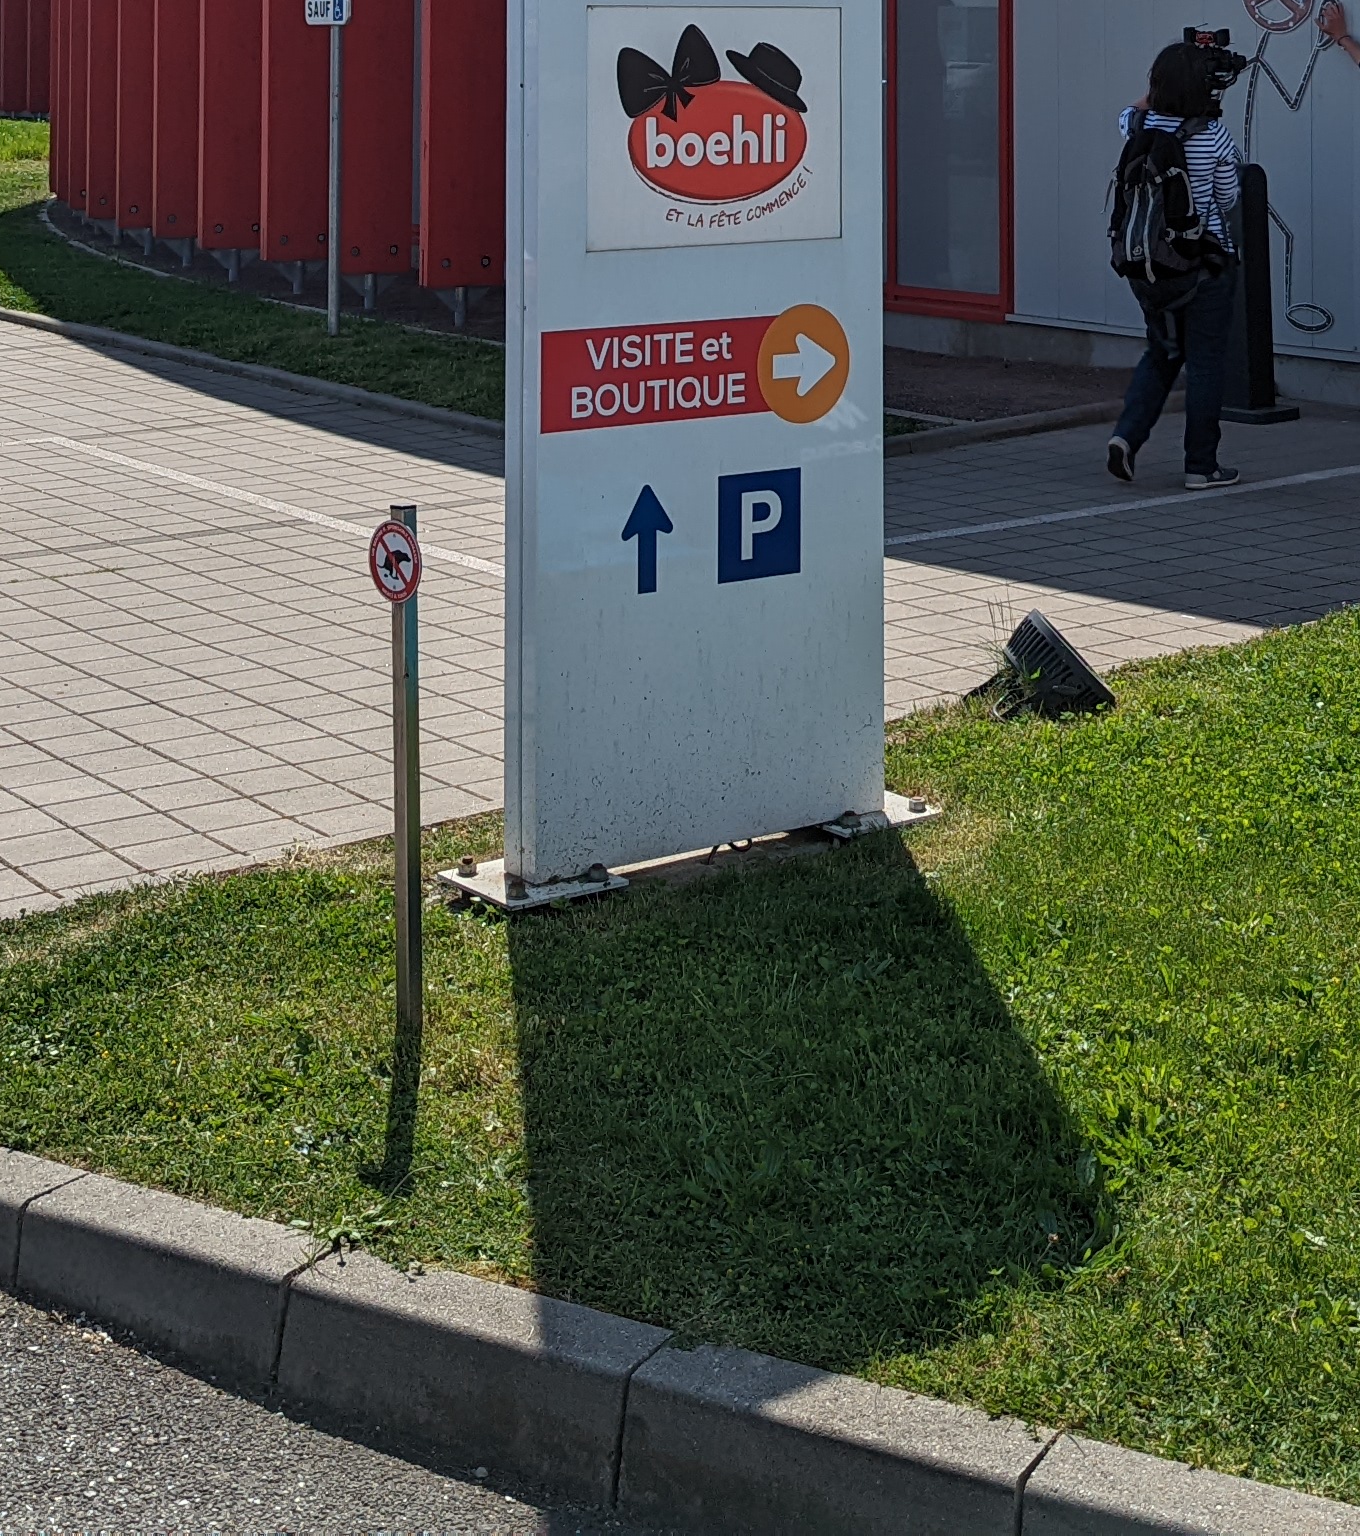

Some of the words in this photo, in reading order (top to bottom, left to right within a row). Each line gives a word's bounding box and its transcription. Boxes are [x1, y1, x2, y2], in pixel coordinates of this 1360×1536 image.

[307, 0, 331, 18] SAUF
[644, 113, 788, 168] boehli
[665, 207, 685, 224] ET
[687, 211, 705, 228] LA
[708, 209, 743, 228] FÊTE
[746, 174, 808, 220] COMMENCE
[585, 330, 695, 371] VISITE
[701, 331, 733, 361] et
[570, 372, 747, 420] BOUTIQUE
[741, 489, 782, 561] P
